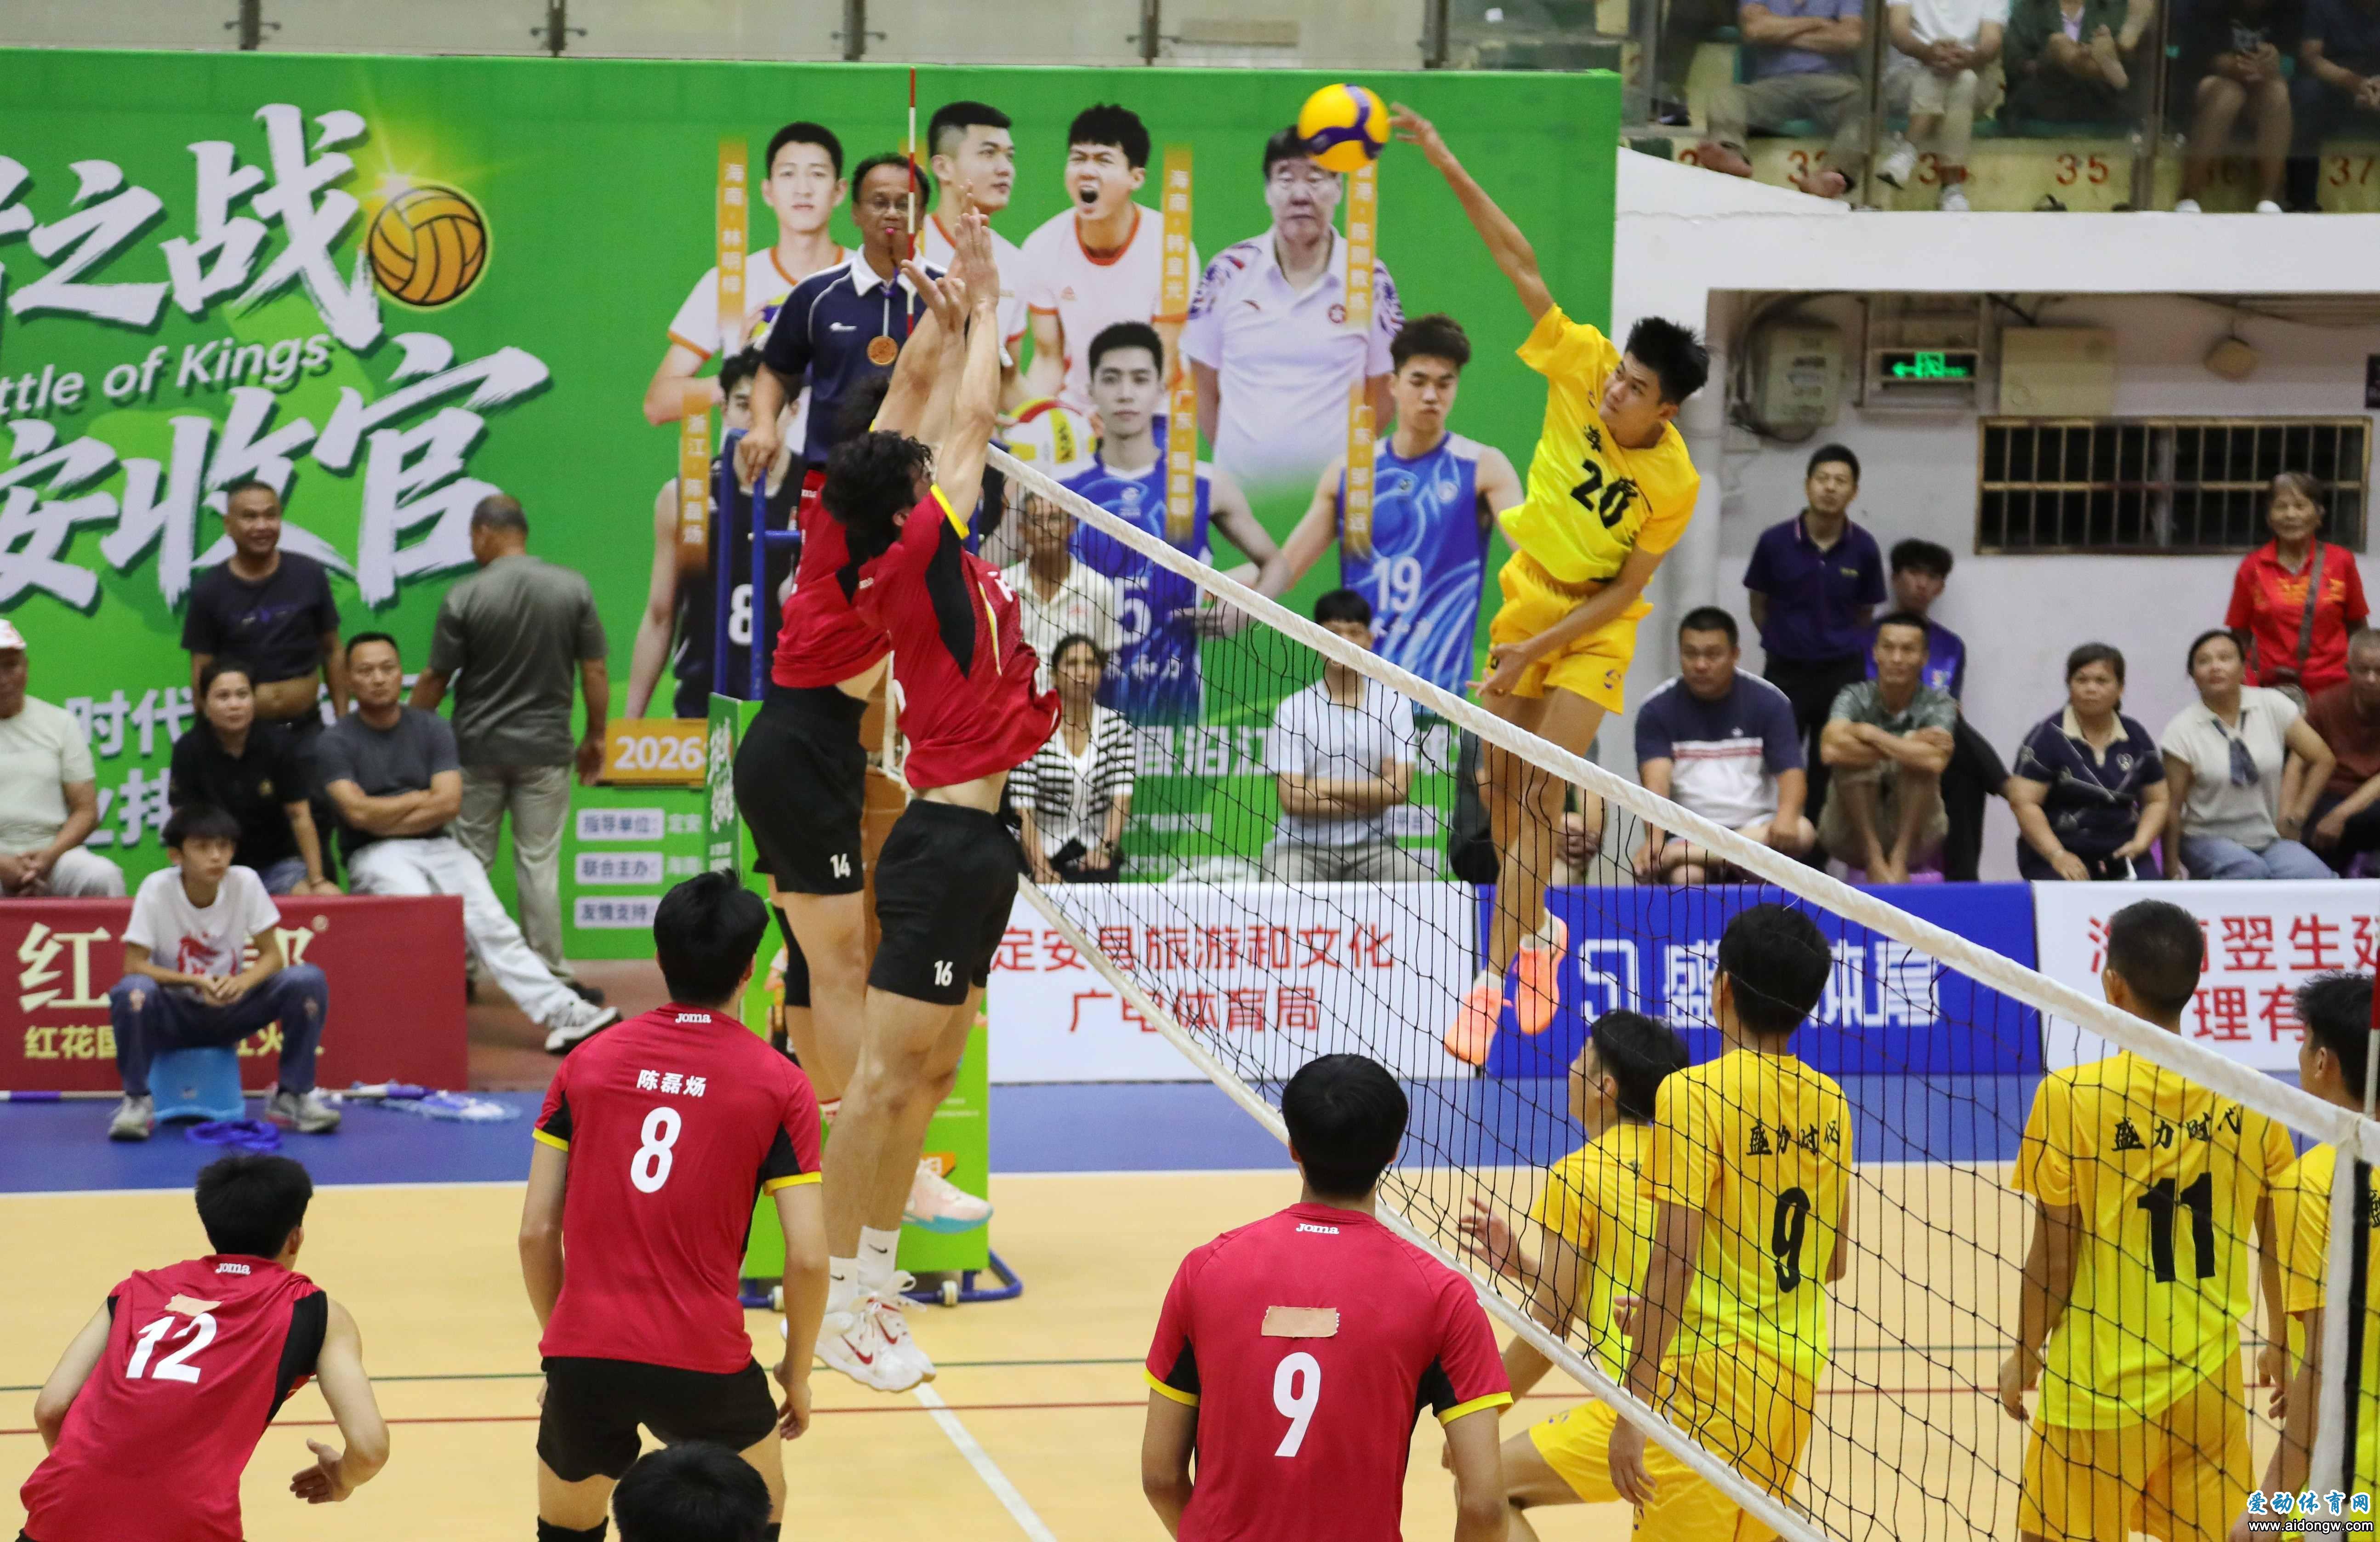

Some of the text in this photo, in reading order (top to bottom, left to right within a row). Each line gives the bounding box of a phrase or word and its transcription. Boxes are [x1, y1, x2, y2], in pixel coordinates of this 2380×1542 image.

[2056, 154, 2108, 185] 35
[2328, 155, 2374, 186] 37
[0, 103, 383, 349] 之战
[103, 347, 166, 398] of
[177, 334, 331, 384] Kings
[1571, 459, 1629, 529] 20
[1373, 556, 1422, 611] 19
[614, 737, 703, 770] 2026
[830, 853, 851, 878] 14
[934, 960, 953, 986] 16
[991, 924, 1395, 973] 定安县旅游和文化
[1069, 986, 1318, 1033] 广电体育局
[1663, 938, 1940, 1028] 盛体育
[636, 1069, 706, 1097] 陈磊炀
[630, 1107, 682, 1194] 8
[2111, 1105, 2242, 1152] 盛力时代
[1772, 1187, 1811, 1293] 9
[2137, 1171, 2215, 1283] 11
[125, 1313, 217, 1384] 12
[1273, 1352, 1321, 1457] 9
